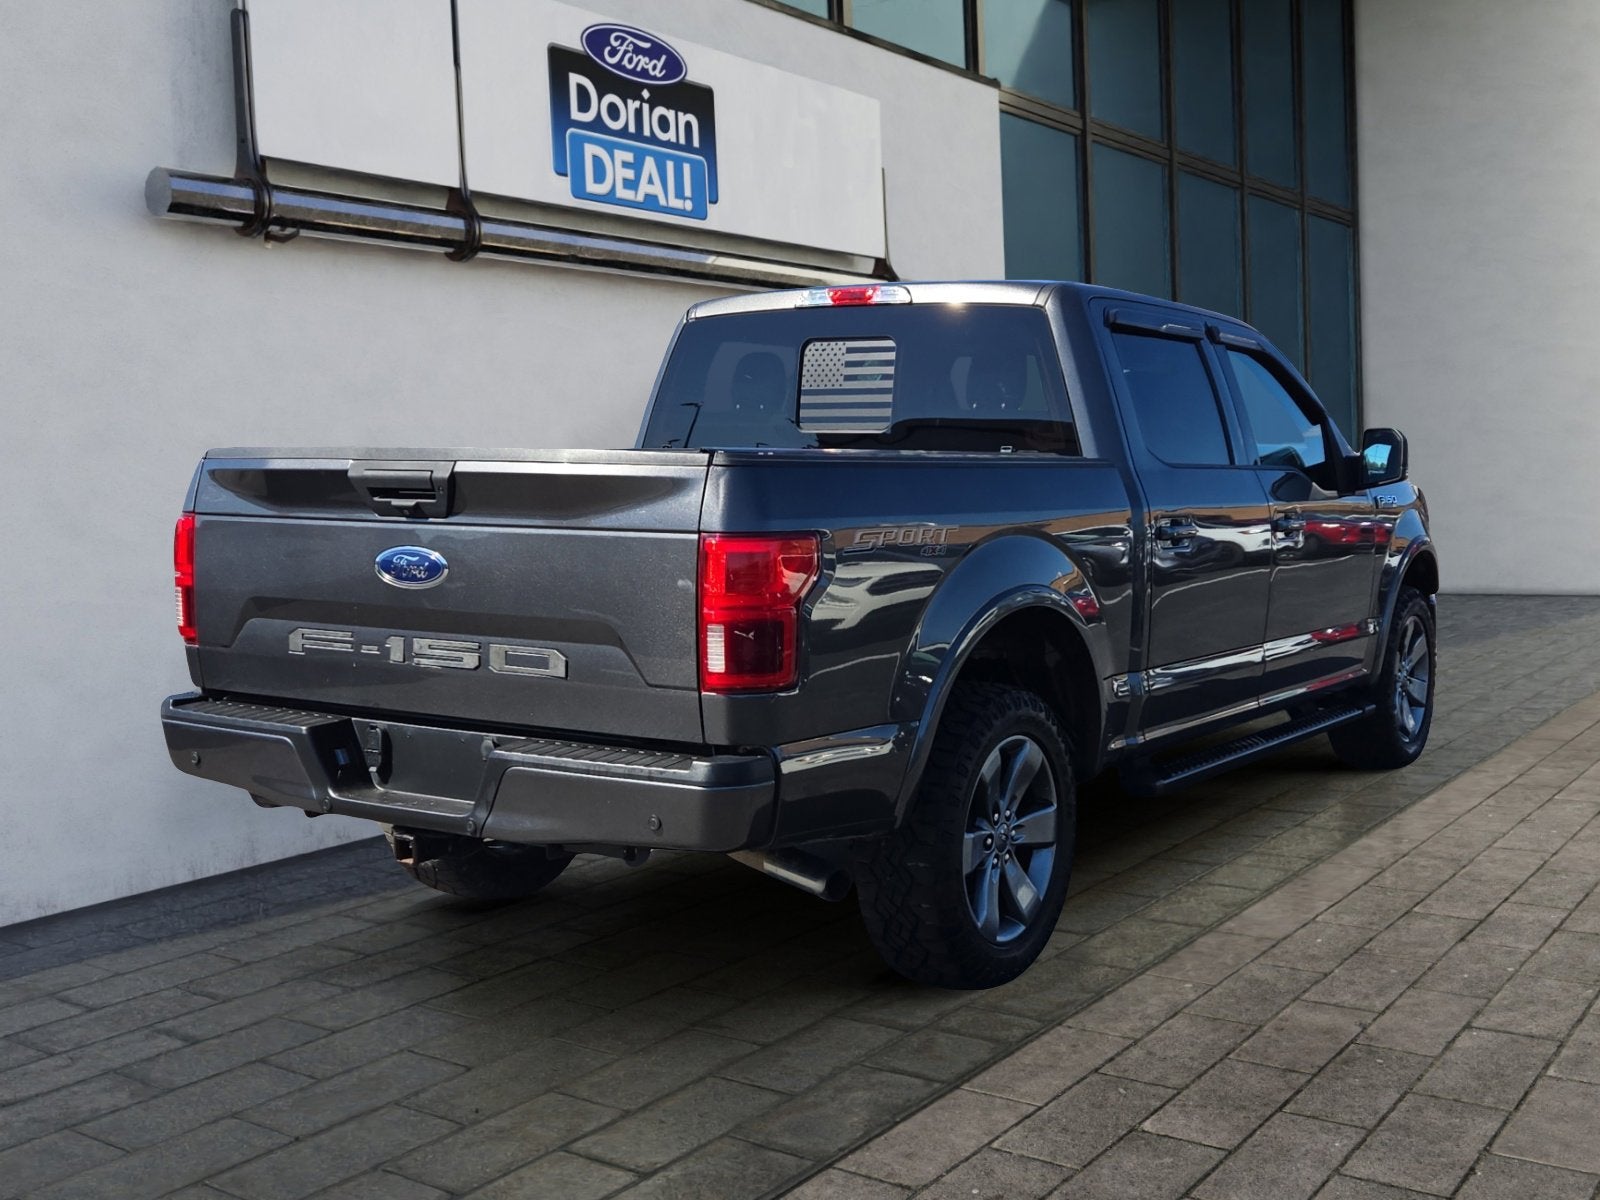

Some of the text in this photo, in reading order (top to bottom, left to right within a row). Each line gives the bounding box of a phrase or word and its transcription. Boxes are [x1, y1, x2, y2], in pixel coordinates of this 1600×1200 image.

[603, 31, 667, 78] Ford
[568, 71, 700, 148] Dorian
[583, 142, 693, 211] DEAL!
[842, 525, 959, 556] SPORT
[391, 554, 429, 579] Ford
[288, 627, 568, 679] F-150
